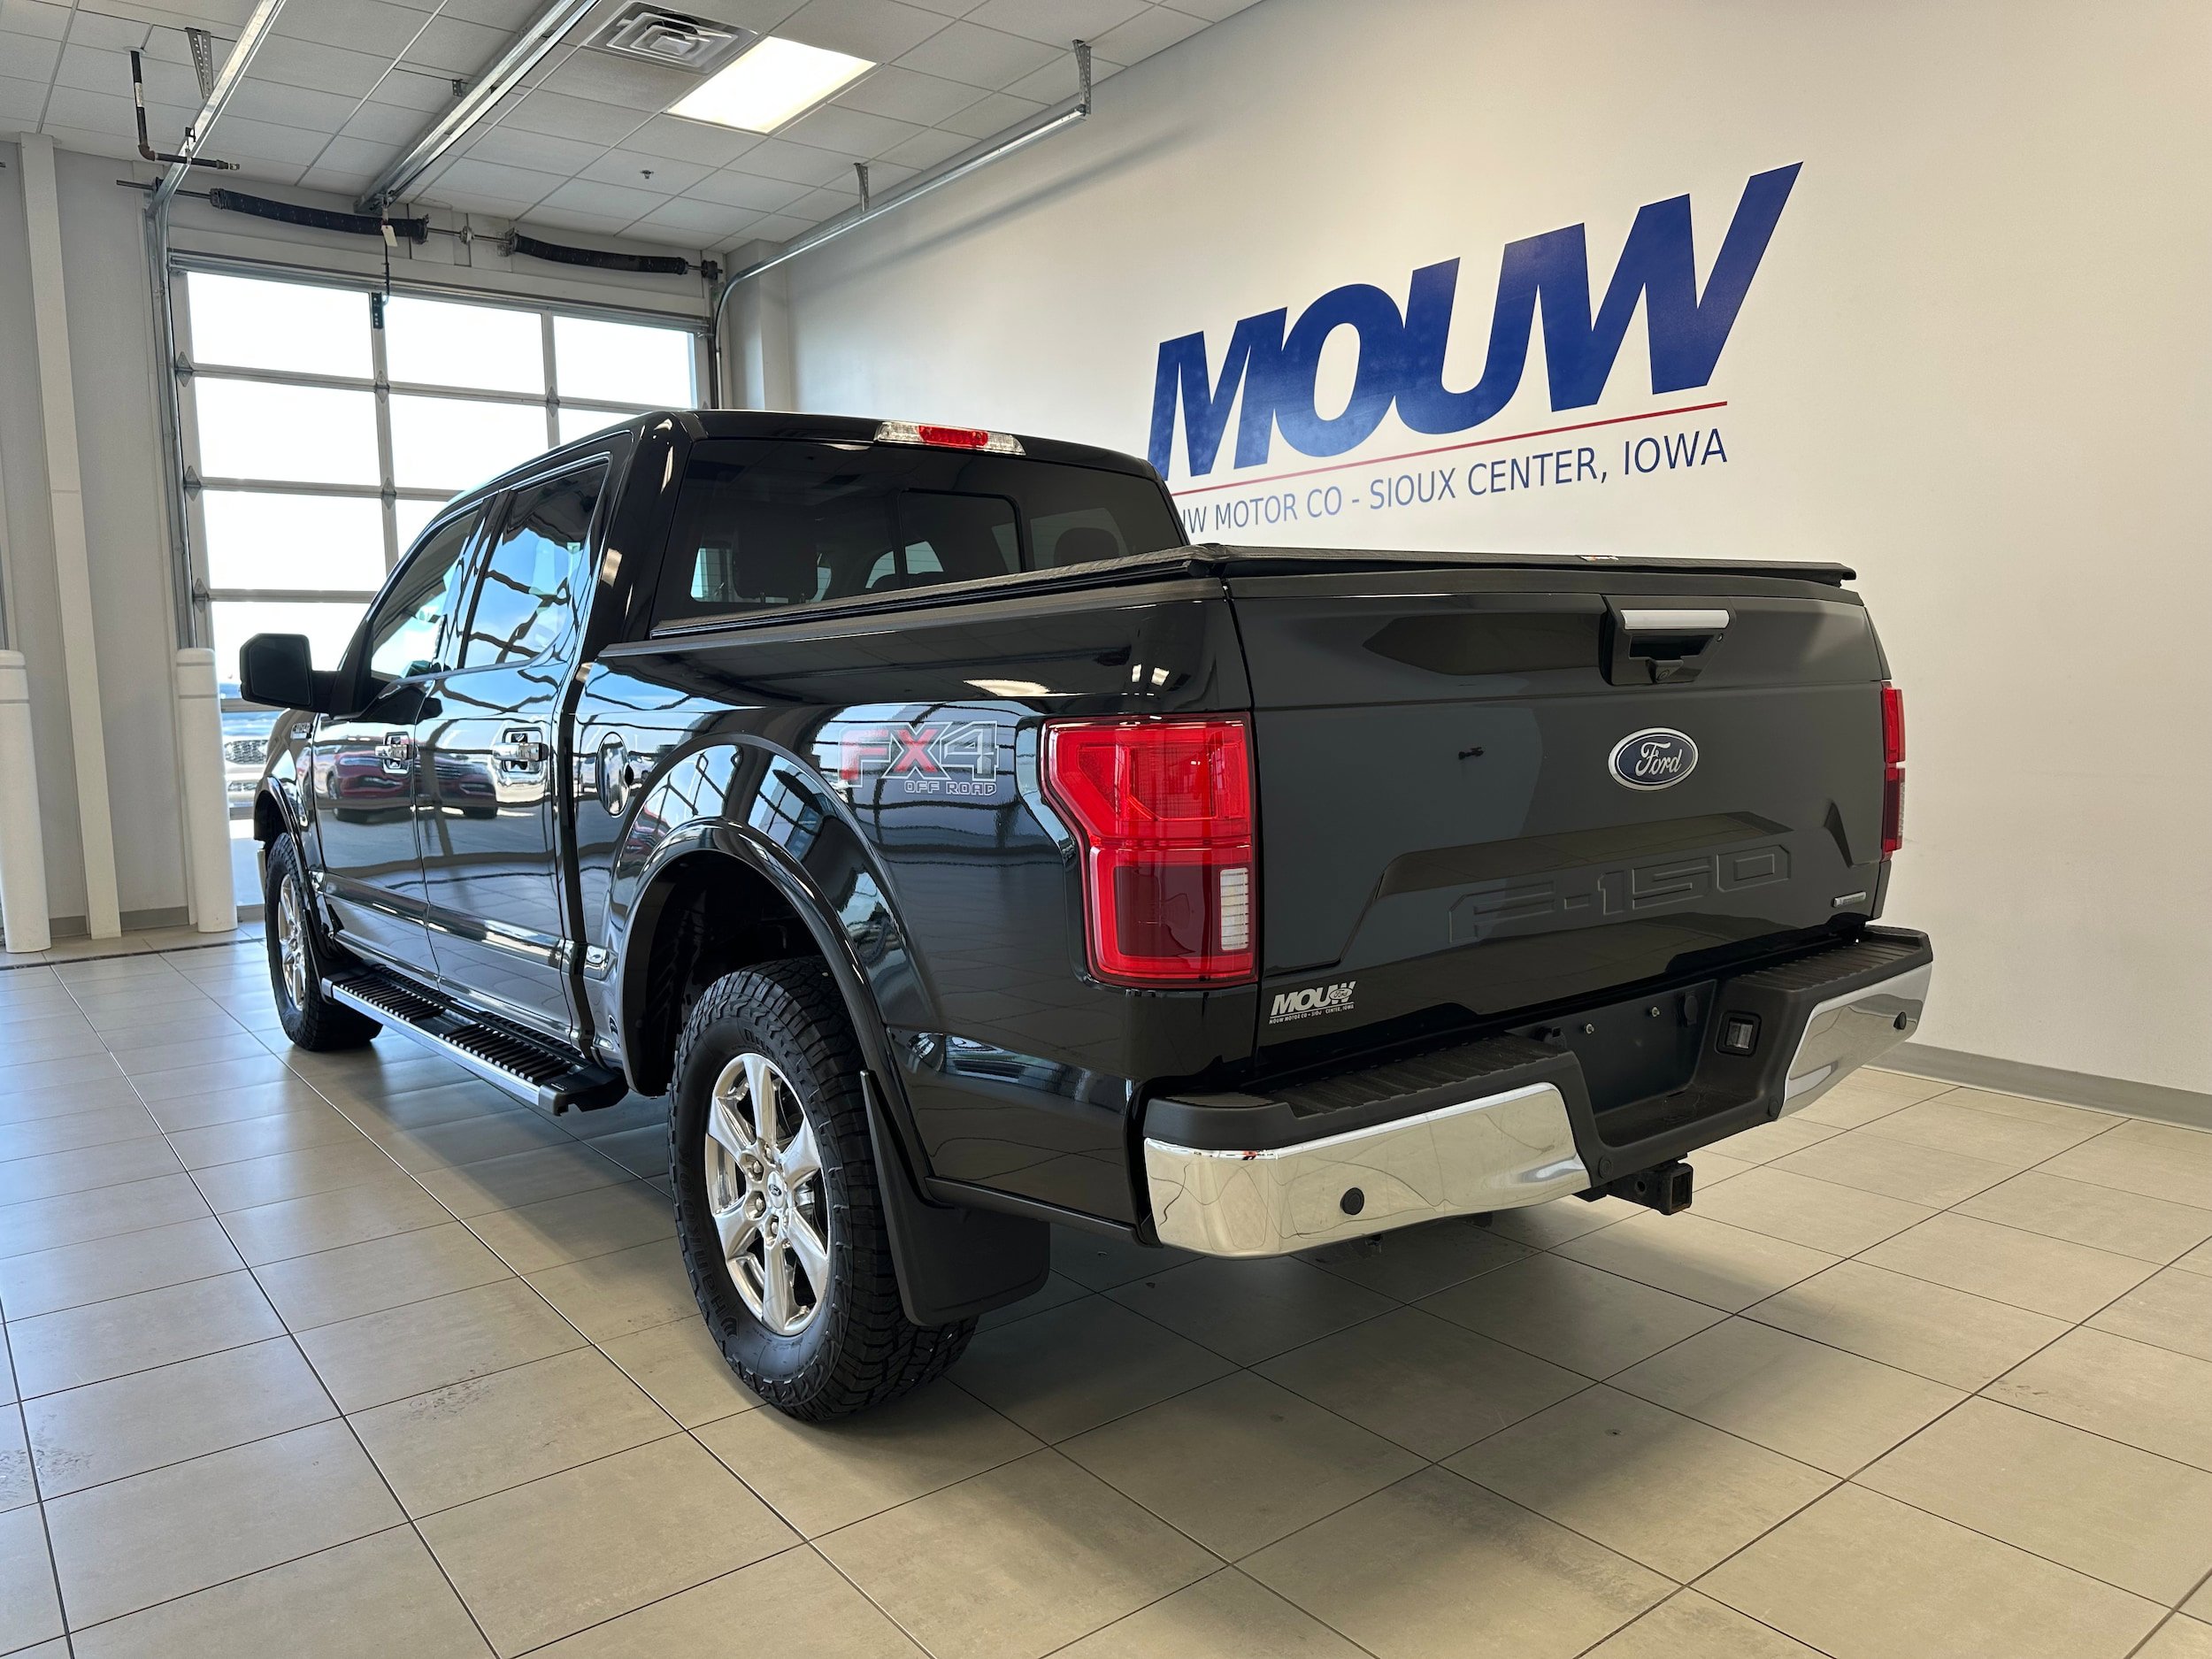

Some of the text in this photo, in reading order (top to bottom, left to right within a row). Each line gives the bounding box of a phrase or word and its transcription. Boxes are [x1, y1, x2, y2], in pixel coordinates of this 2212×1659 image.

[1148, 161, 1803, 481] MOUW
[1215, 493, 1298, 531] MOTOR
[1307, 486, 1342, 518] CO
[1369, 466, 1456, 511] SIOUX
[1467, 446, 1608, 496] CENTER,
[1623, 427, 1728, 476] IOWA
[838, 720, 1000, 788] FX4
[904, 780, 997, 796] OFF ROAD
[1635, 741, 1683, 777] Ford
[1448, 844, 1791, 944] F-150
